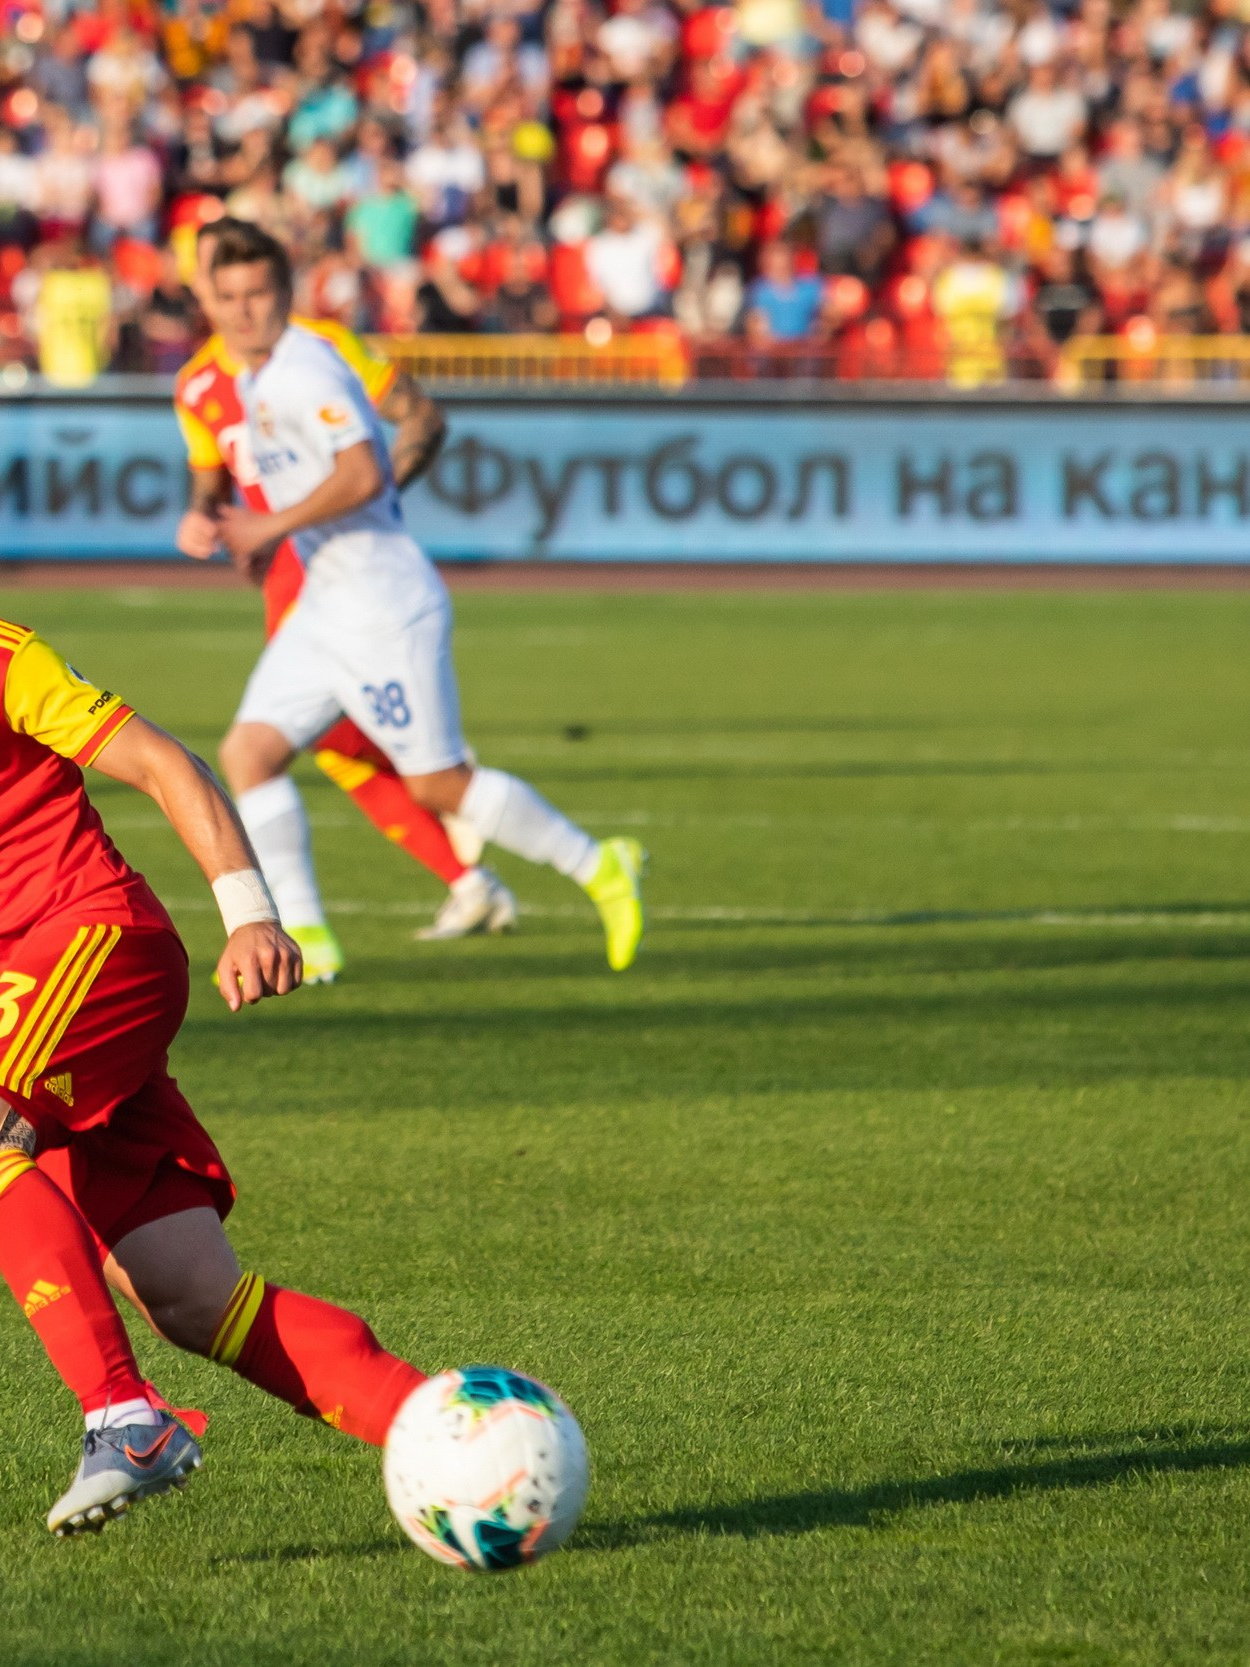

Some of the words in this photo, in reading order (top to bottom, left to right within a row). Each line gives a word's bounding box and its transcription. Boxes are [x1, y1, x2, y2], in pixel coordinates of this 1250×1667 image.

[428, 434, 851, 541] Футбол
[895, 452, 1018, 522] на
[1062, 452, 1250, 522] кан
[362, 682, 412, 728] 38
[44, 1080, 75, 1108] adidas
